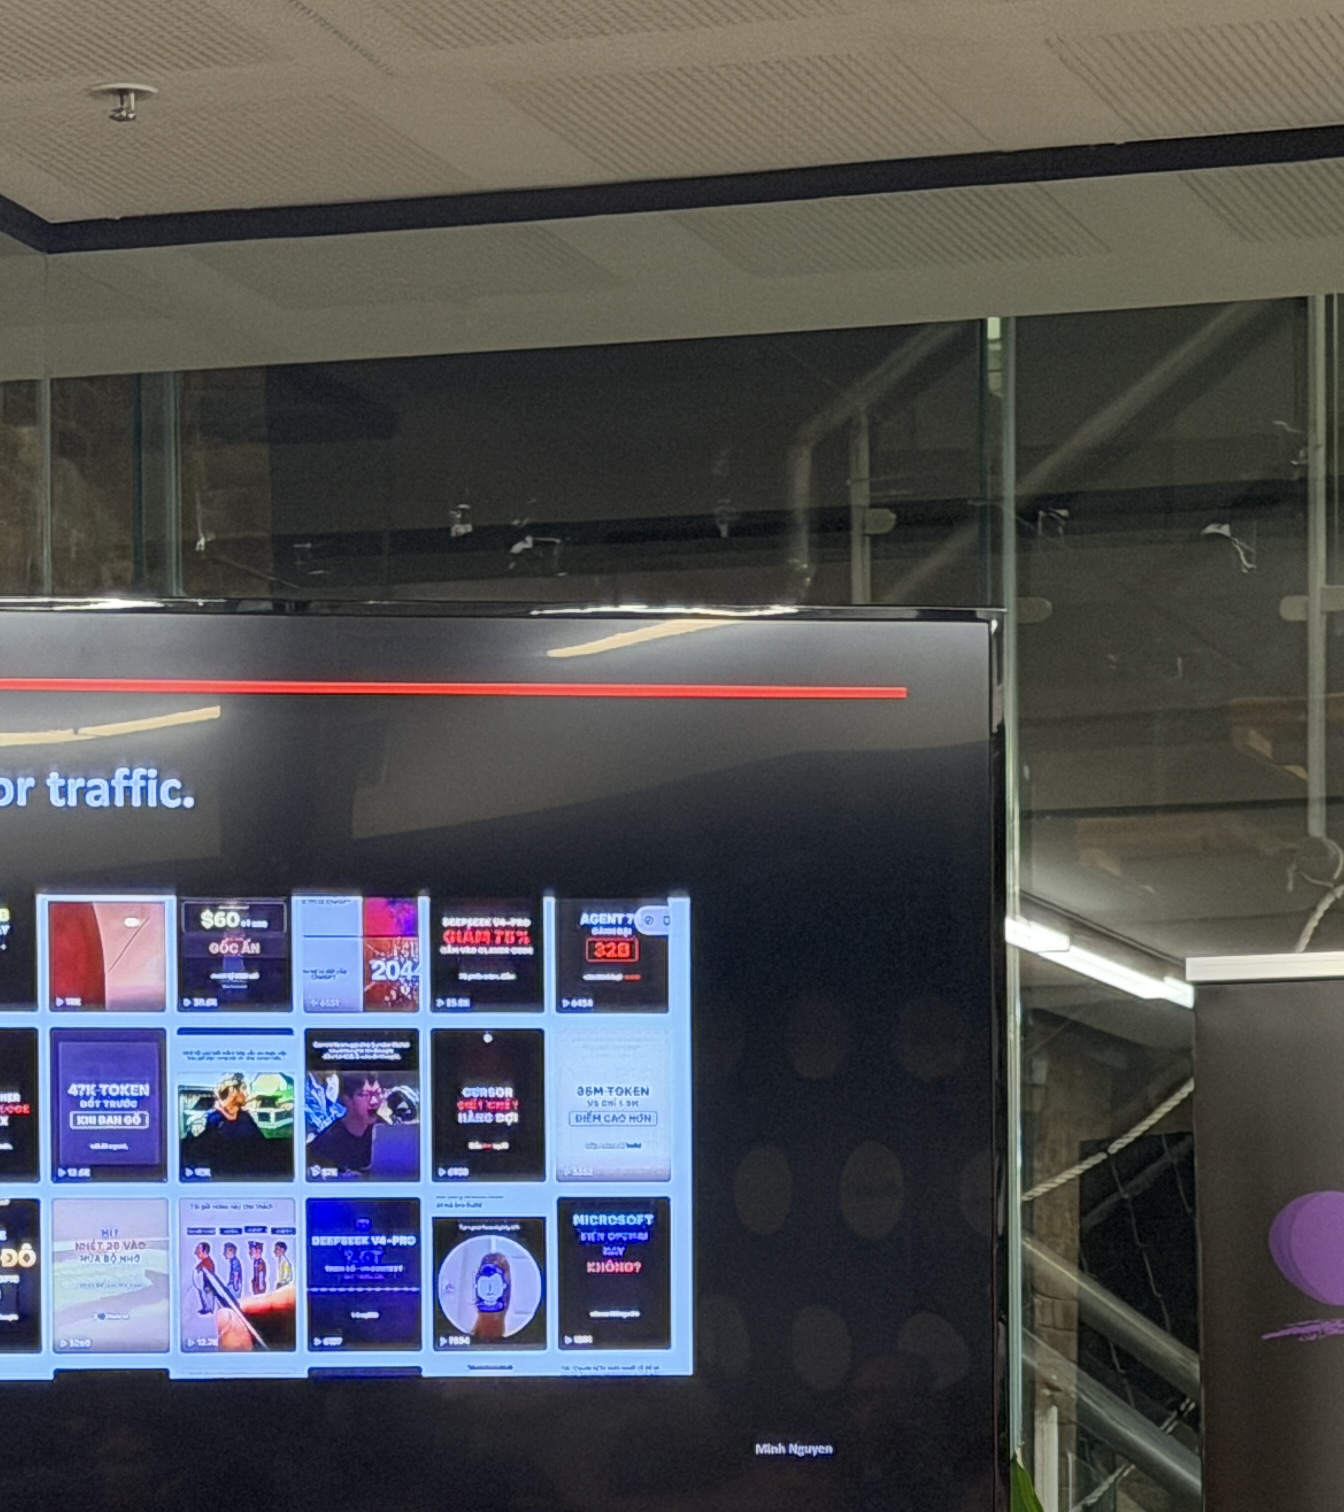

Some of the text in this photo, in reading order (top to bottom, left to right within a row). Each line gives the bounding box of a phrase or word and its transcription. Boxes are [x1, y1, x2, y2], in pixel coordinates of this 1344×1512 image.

[46, 767, 195, 809] traffic.
[200, 909, 241, 929] $60
[579, 912, 624, 926] AGENT
[98, 1083, 150, 1097] TOKEN
[606, 1086, 650, 1097] TOKEN
[572, 1213, 655, 1226] MICROSOFT
[755, 1442, 834, 1457] Minh Nguyen
